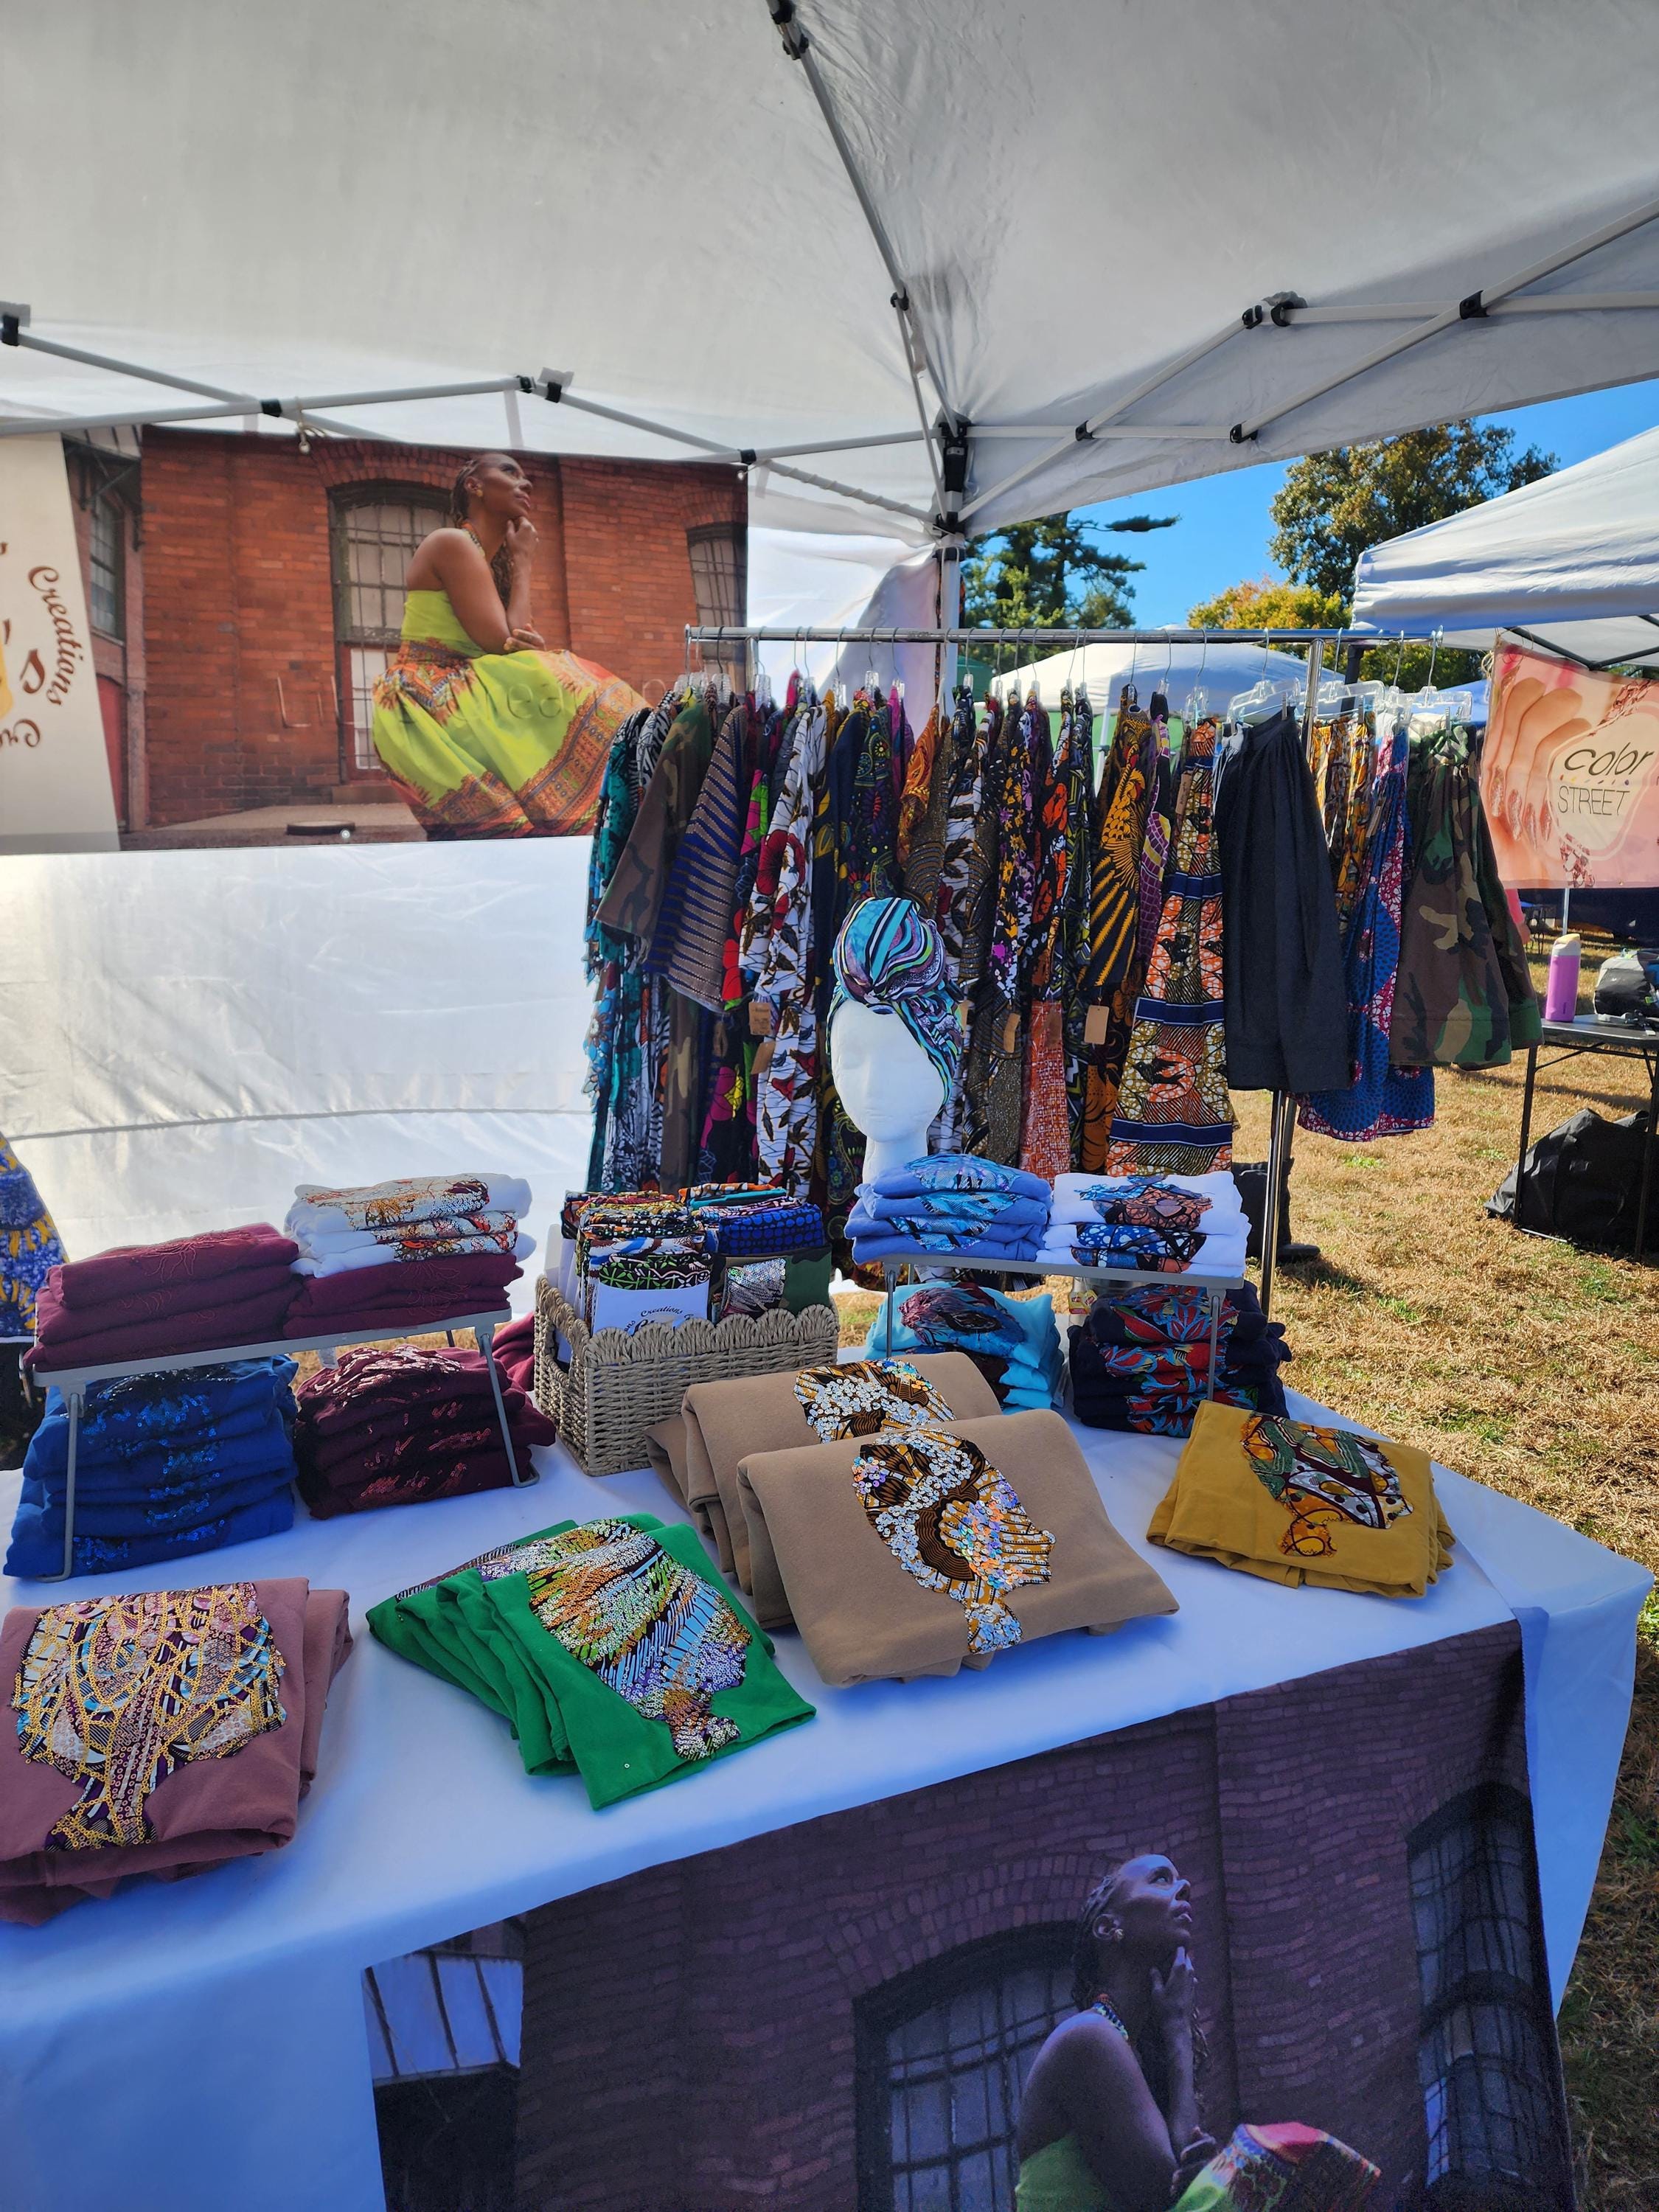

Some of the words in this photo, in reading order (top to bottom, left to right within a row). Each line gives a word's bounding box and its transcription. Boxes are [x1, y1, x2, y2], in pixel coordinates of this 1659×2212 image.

[28, 565, 84, 706] Creations
[1557, 785, 1630, 816] STREET
[640, 1305, 684, 1318] Creations
